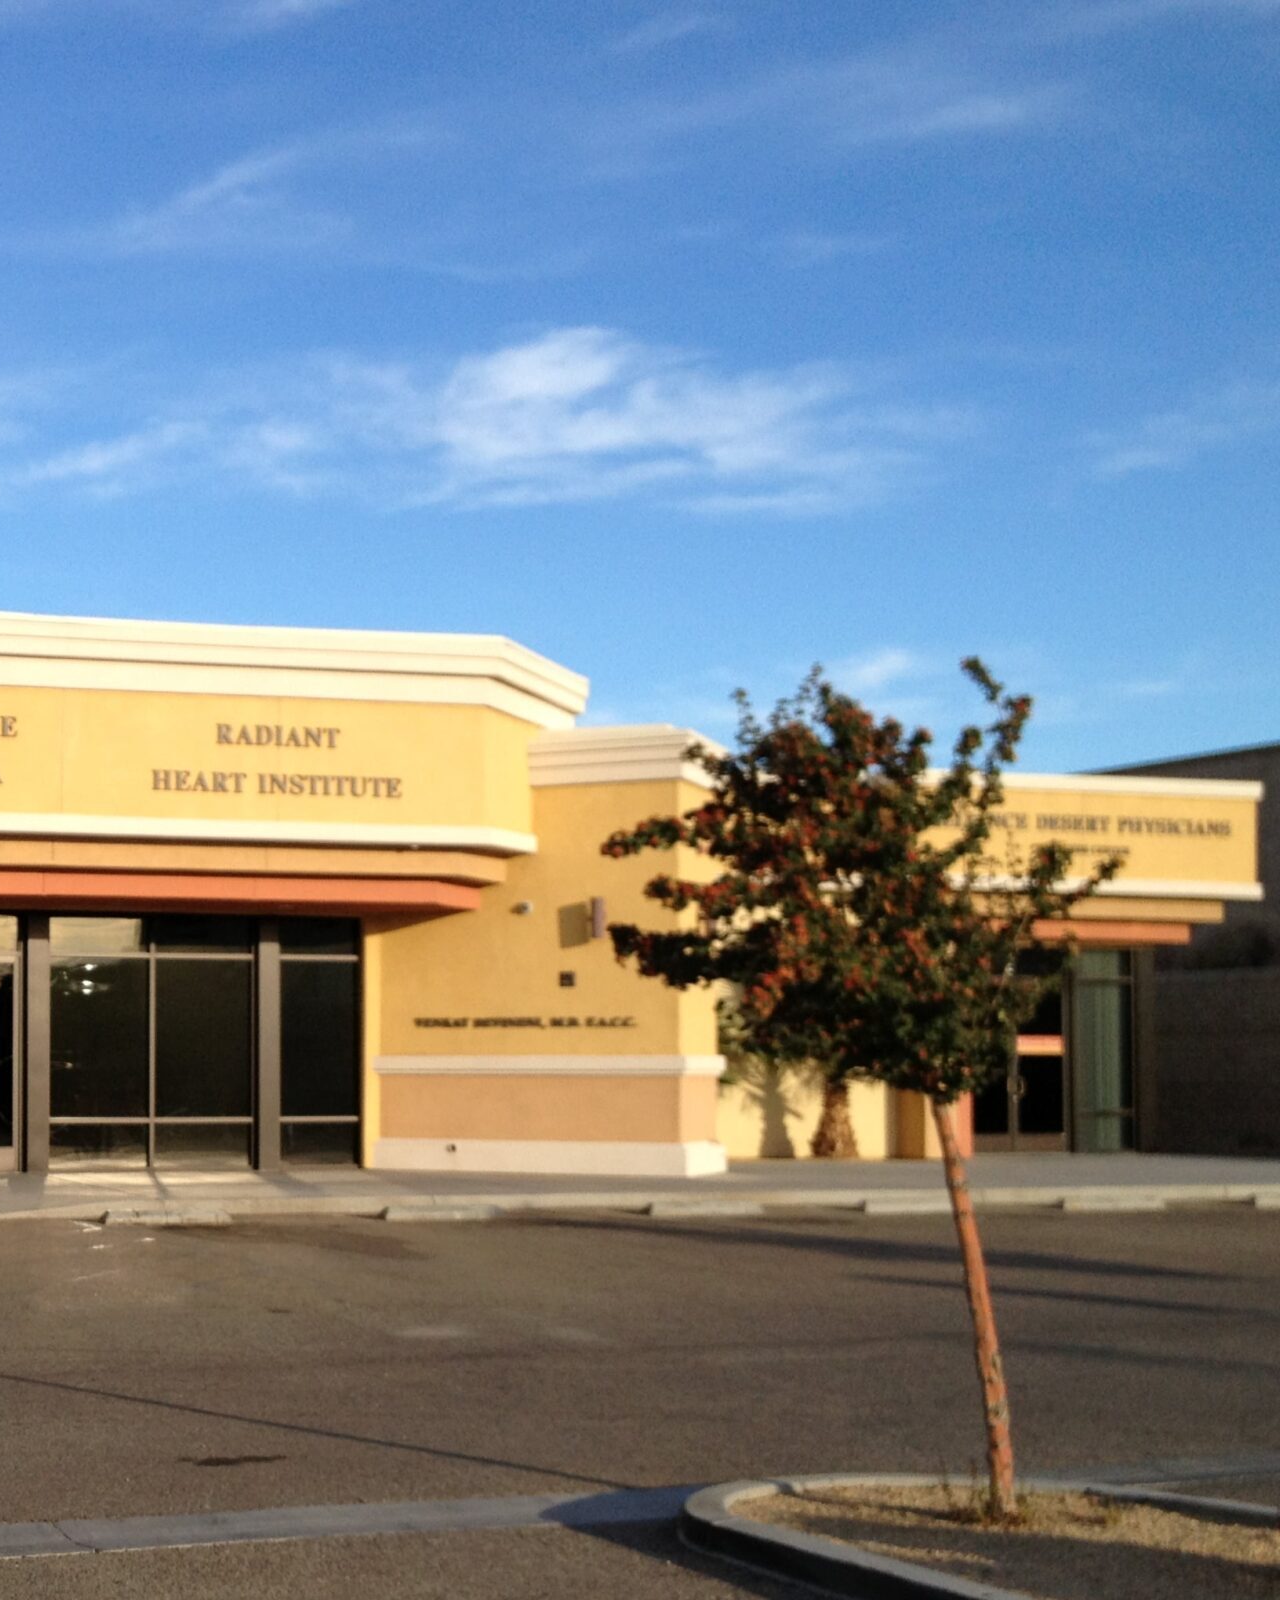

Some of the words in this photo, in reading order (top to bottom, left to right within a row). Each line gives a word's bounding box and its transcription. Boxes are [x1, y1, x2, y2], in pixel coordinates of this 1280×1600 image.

[215, 723, 340, 749] RADIANT
[151, 769, 246, 793] HEART
[257, 773, 402, 798] INSTITUTE
[1035, 814, 1110, 834] DESERT
[1117, 816, 1232, 838] PHYSICIANS
